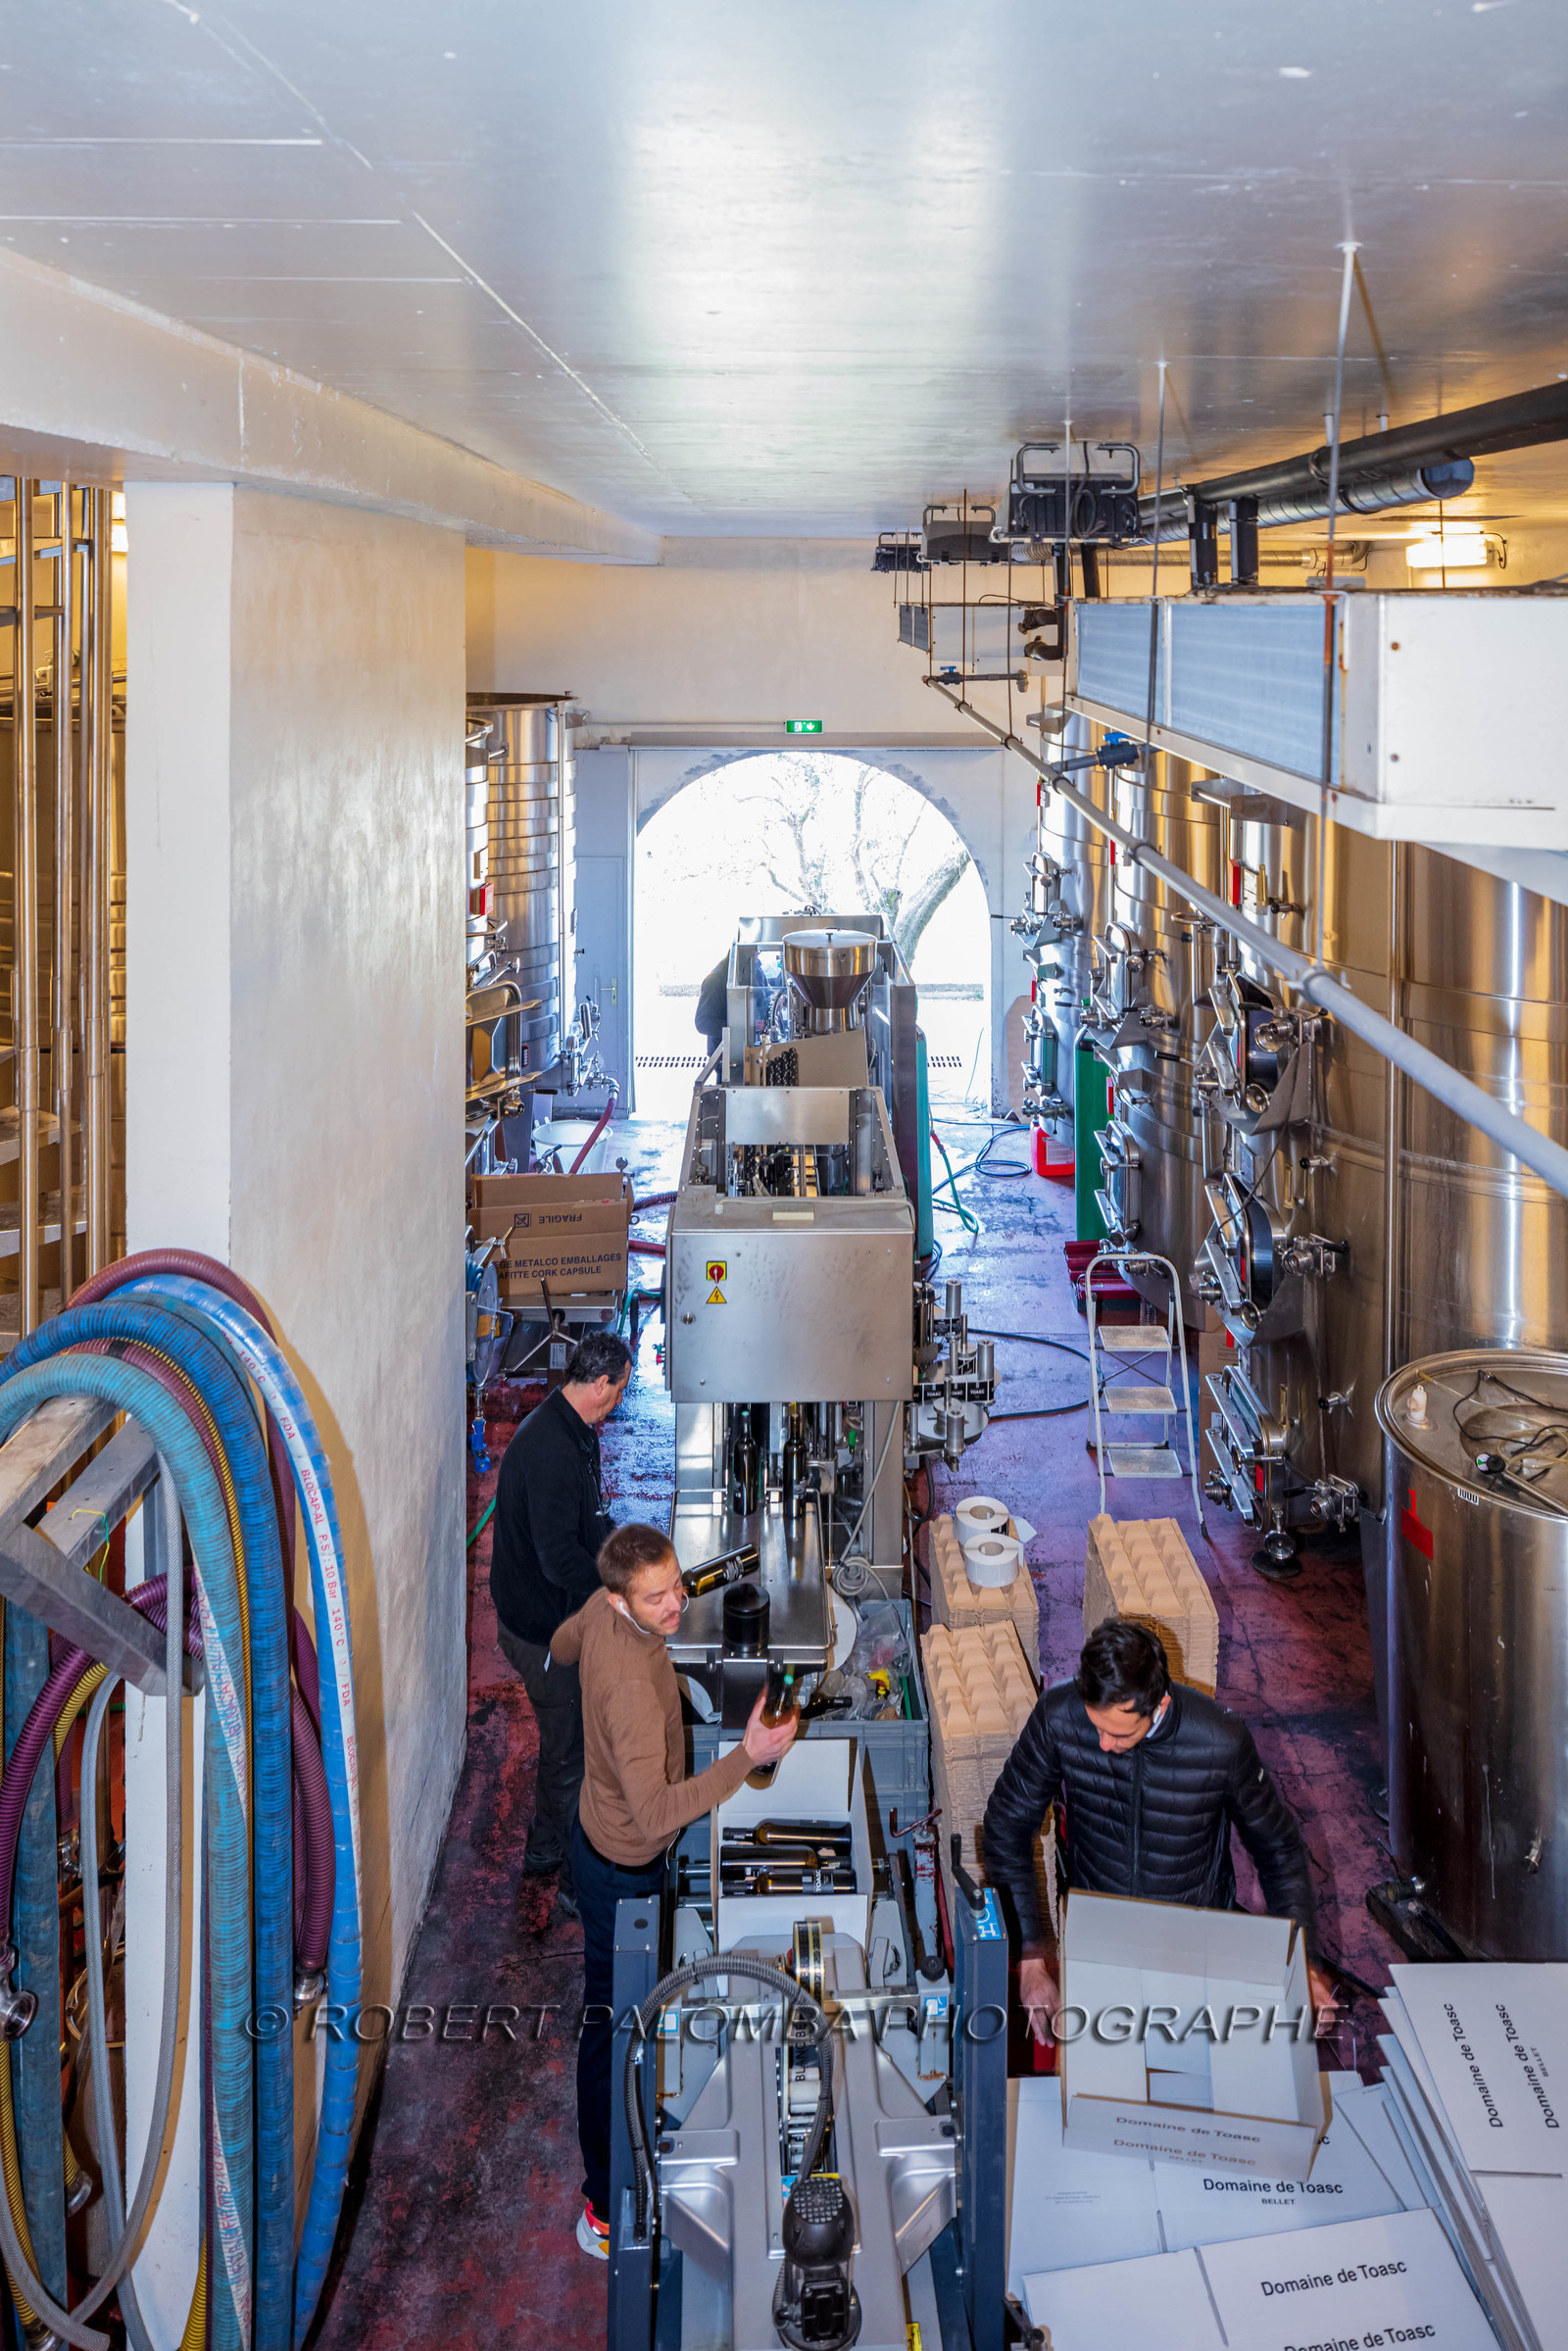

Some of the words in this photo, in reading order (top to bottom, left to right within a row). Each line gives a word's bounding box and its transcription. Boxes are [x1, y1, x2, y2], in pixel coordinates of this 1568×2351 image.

[539, 1213, 582, 1224] FRAGILE
[514, 1257, 559, 1269] METALCO
[561, 1252, 621, 1265] EMBALLAGES
[499, 1270, 529, 1280] AFITTE
[531, 1268, 558, 1278] CORK
[560, 1265, 602, 1276] CAPSULE
[325, 1565, 335, 1579] 10
[327, 1582, 337, 1599] Bar
[340, 1684, 351, 1707] FDA
[1444, 2003, 1466, 2041] Toasc
[1495, 2004, 1519, 2042] Toasc
[795, 2041, 806, 2082] BLANC
[1460, 2044, 1475, 2061] de
[1514, 2044, 1529, 2062] de
[1531, 2046, 1549, 2077] BELLET
[1469, 2065, 1503, 2128] Domaine
[1523, 2065, 1560, 2129] Domaine
[1116, 2117, 1186, 2131] Domaine
[1213, 2130, 1260, 2142] Toasc
[1113, 2139, 1183, 2155] Domaine
[1210, 2152, 1256, 2165] Toasc
[1203, 2179, 1271, 2192] Domaine
[1276, 2180, 1295, 2193] de
[1297, 2181, 1344, 2193] Toasc
[1260, 2274, 1334, 2296] Domaine
[1337, 2269, 1357, 2283] de
[1357, 2261, 1407, 2279] Toasc
[1363, 2332, 1385, 2348] de
[1384, 2325, 1436, 2344] Toasc
